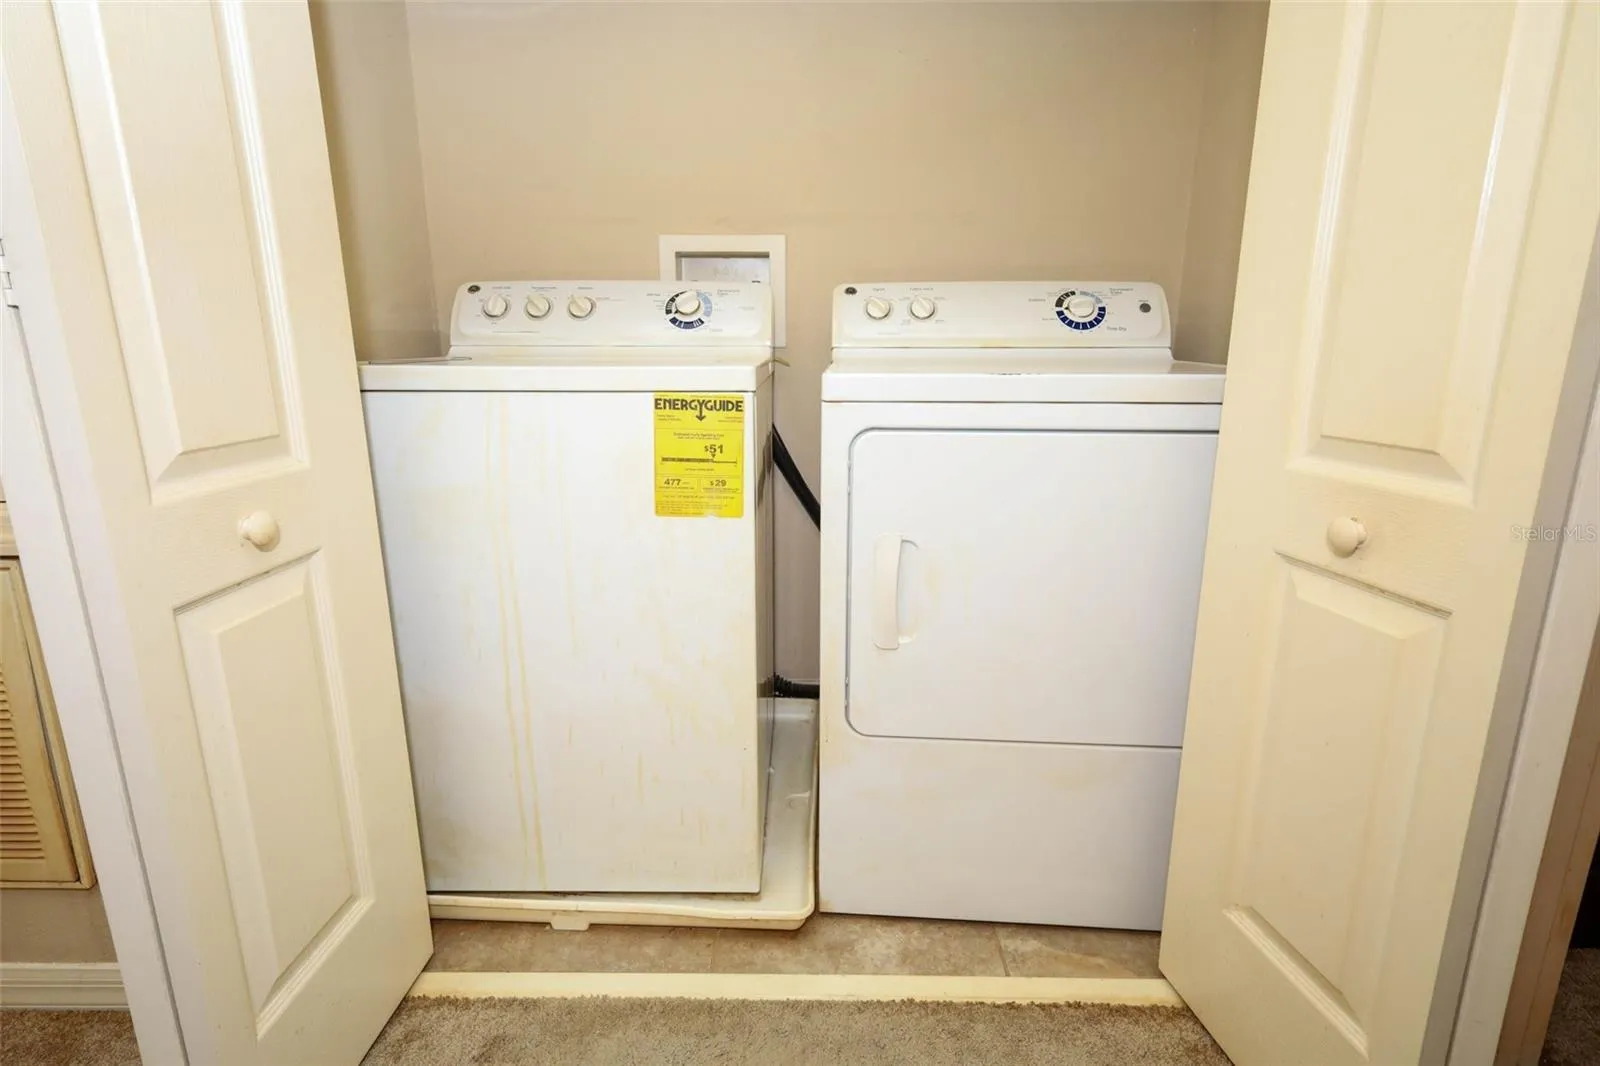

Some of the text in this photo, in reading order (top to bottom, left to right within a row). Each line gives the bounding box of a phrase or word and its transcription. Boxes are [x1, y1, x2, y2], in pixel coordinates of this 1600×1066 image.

[654, 398, 744, 412] ENERGYGUIDE
[704, 444, 724, 454] $51
[664, 478, 681, 486] 477
